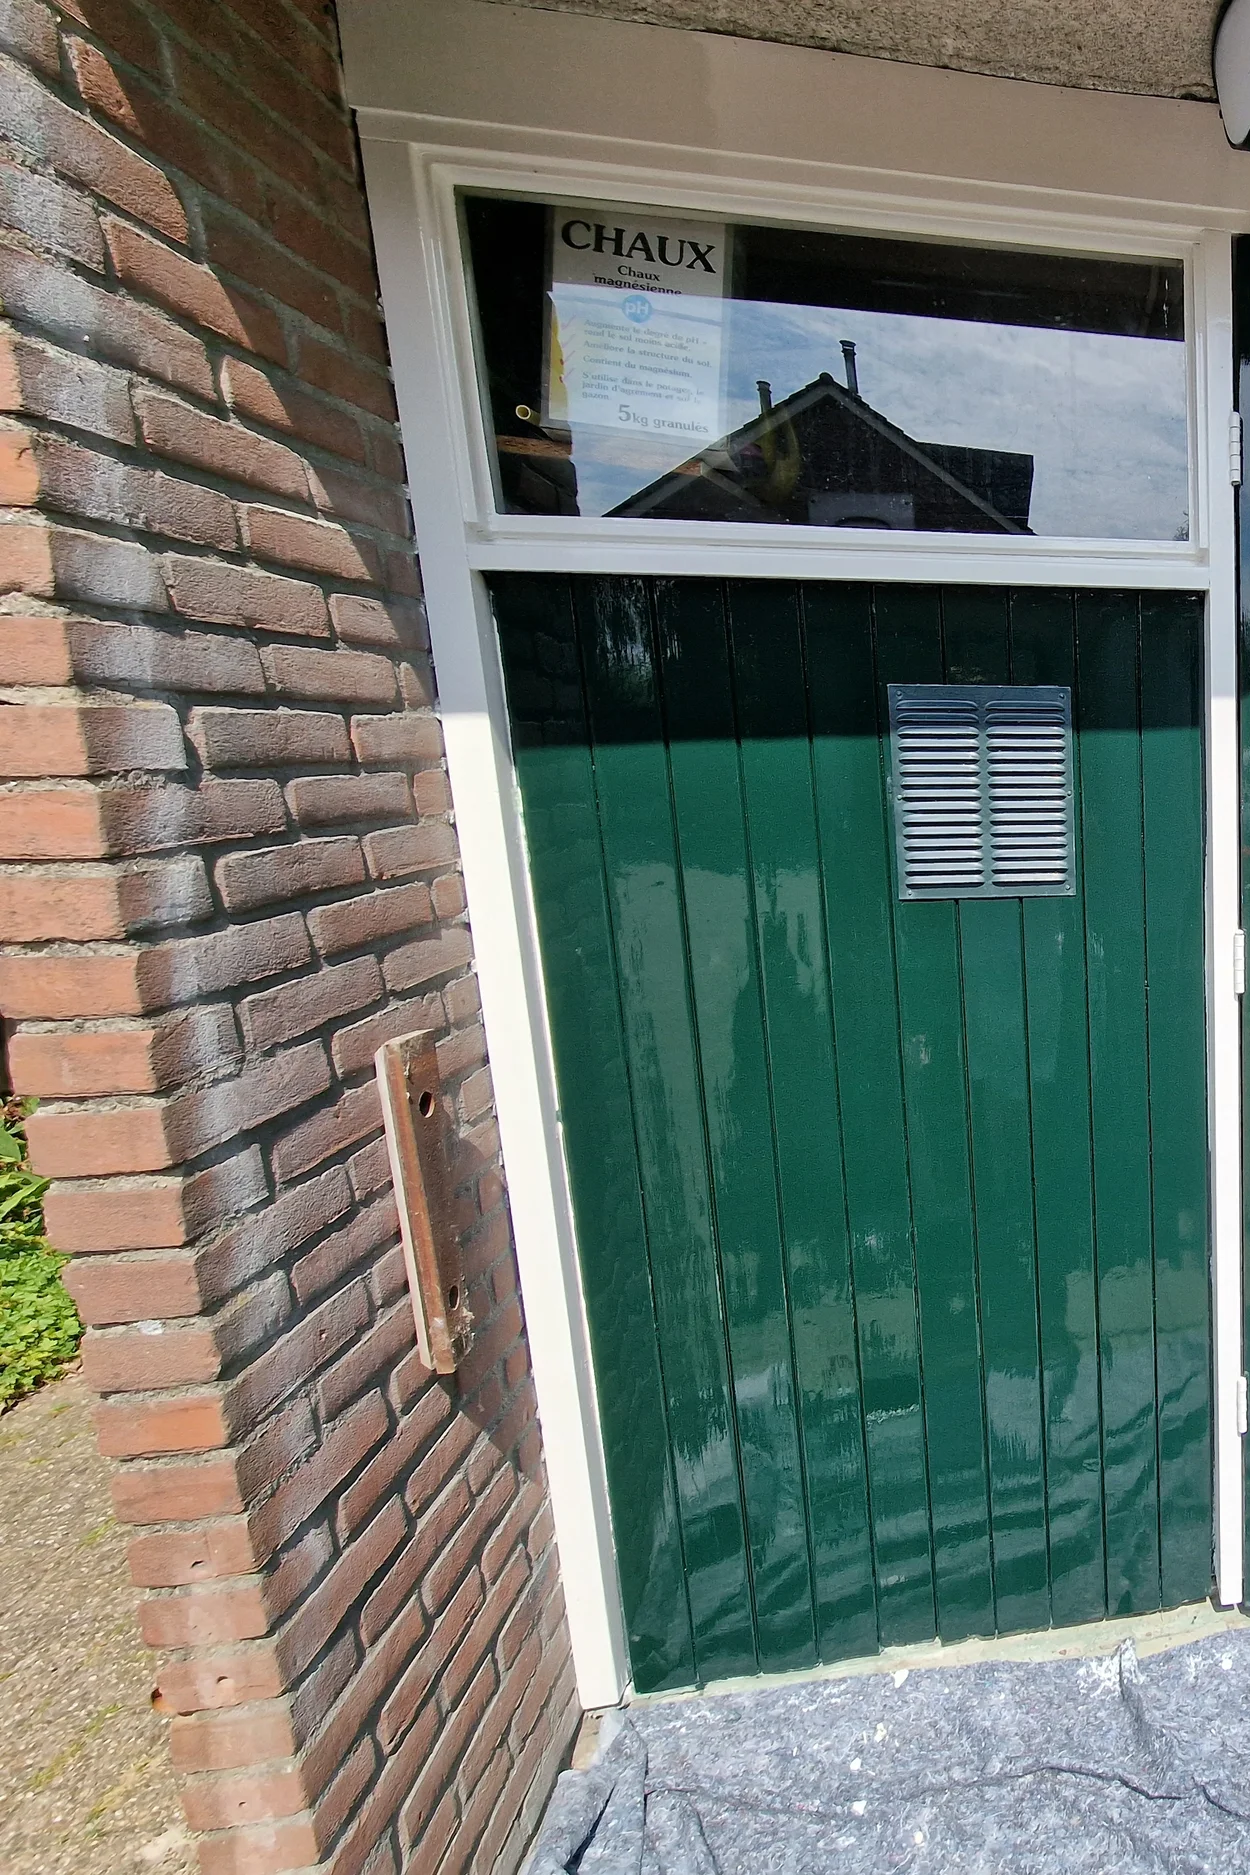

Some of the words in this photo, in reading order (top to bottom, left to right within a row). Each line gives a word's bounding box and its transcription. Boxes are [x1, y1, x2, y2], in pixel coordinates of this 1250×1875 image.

[561, 220, 716, 273] CHAUX
[617, 265, 660, 281] Chaux
[625, 302, 649, 316] pH
[619, 333, 632, 342] sol
[583, 355, 621, 367] Contient
[624, 361, 636, 369] du
[627, 345, 635, 354] la
[639, 349, 679, 362] structure
[682, 356, 694, 365] du
[697, 360, 712, 368] sol.
[622, 377, 643, 387] dans
[653, 417, 709, 434] granulés
